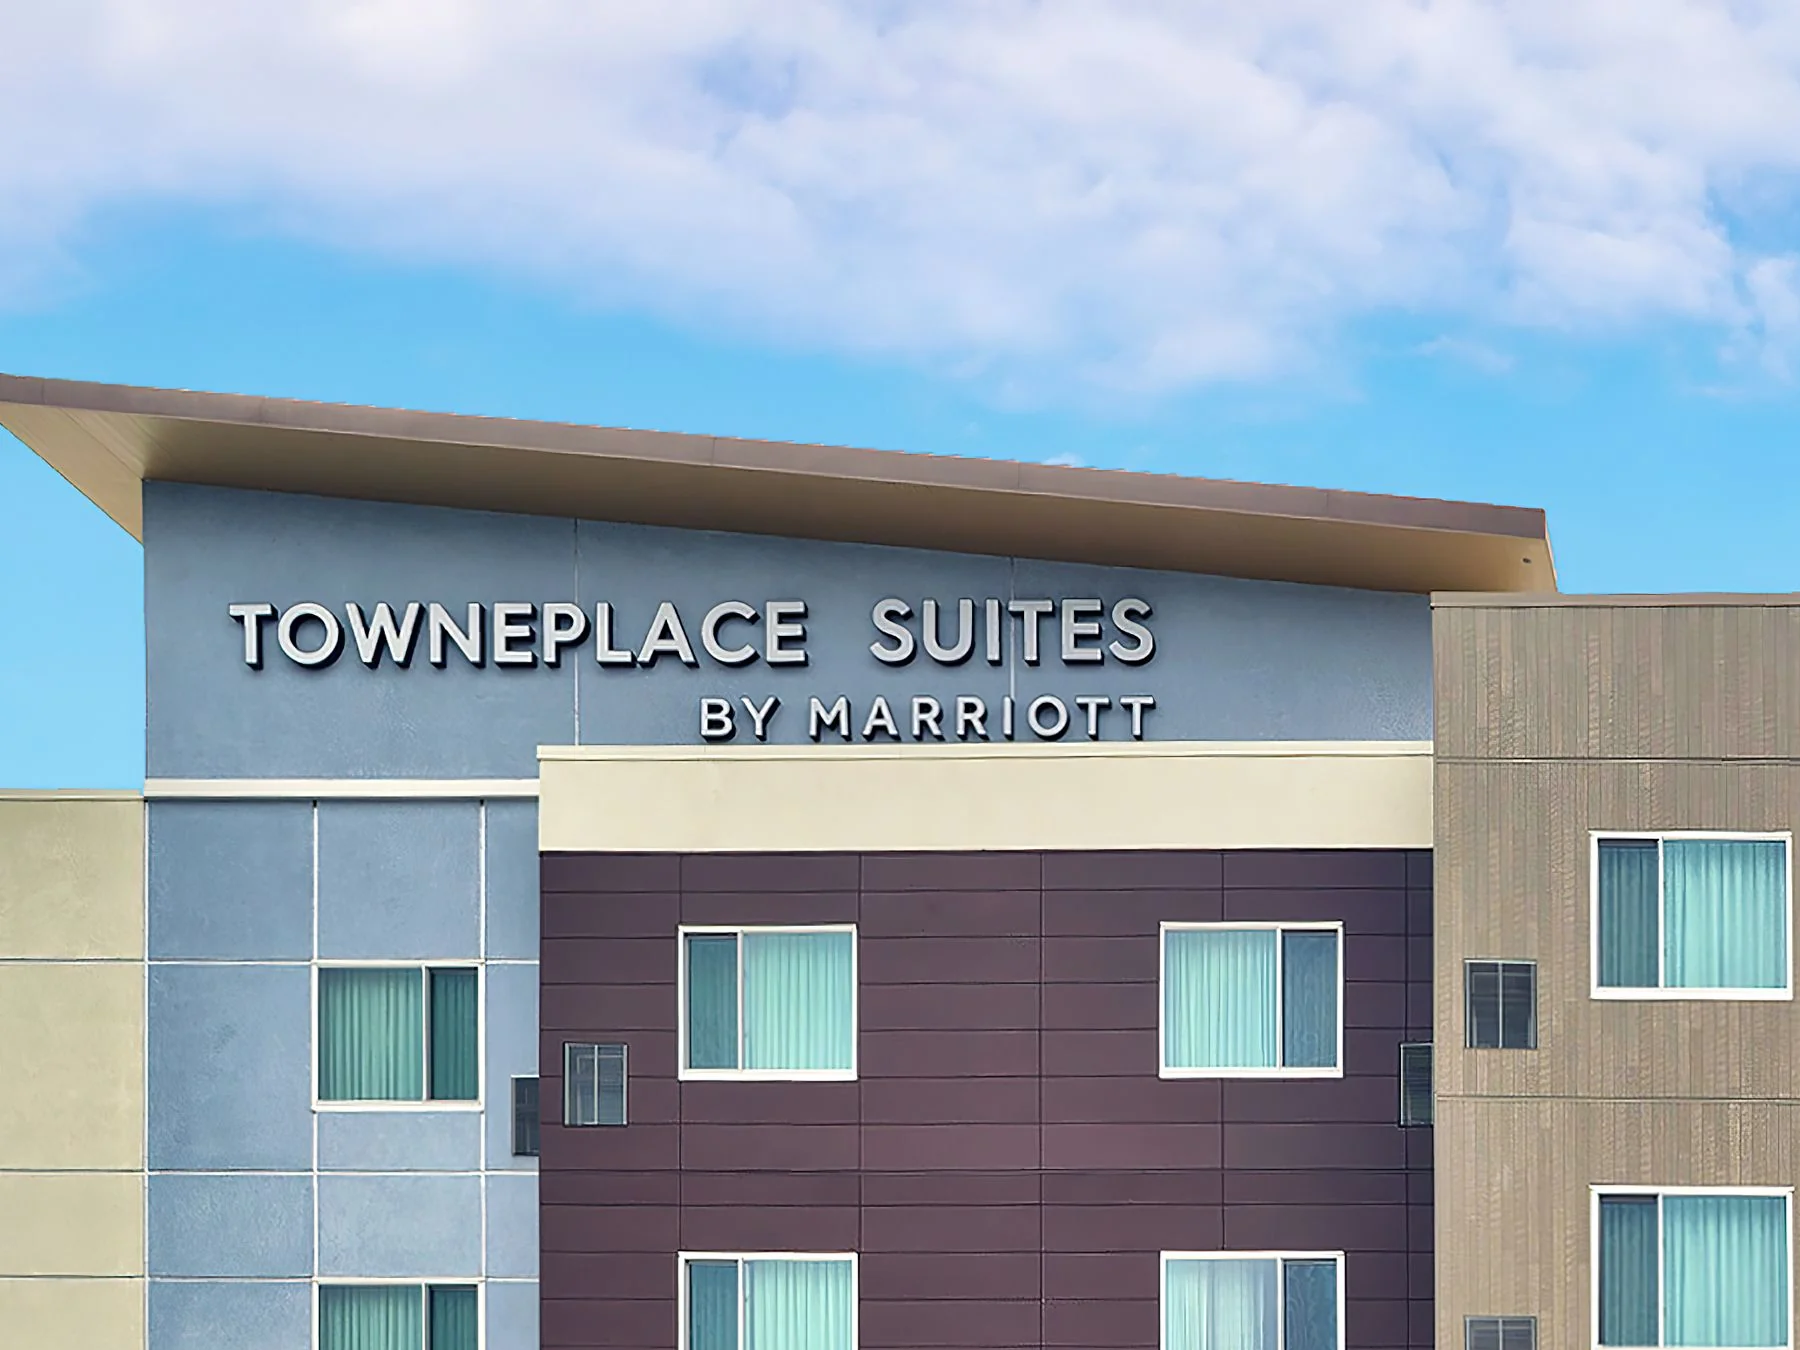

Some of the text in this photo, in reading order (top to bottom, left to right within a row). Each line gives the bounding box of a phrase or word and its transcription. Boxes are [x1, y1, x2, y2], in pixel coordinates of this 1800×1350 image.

[229, 598, 1156, 668] TOWNEPLACE SUITES
[700, 695, 1155, 740] BY MARRIOTT
